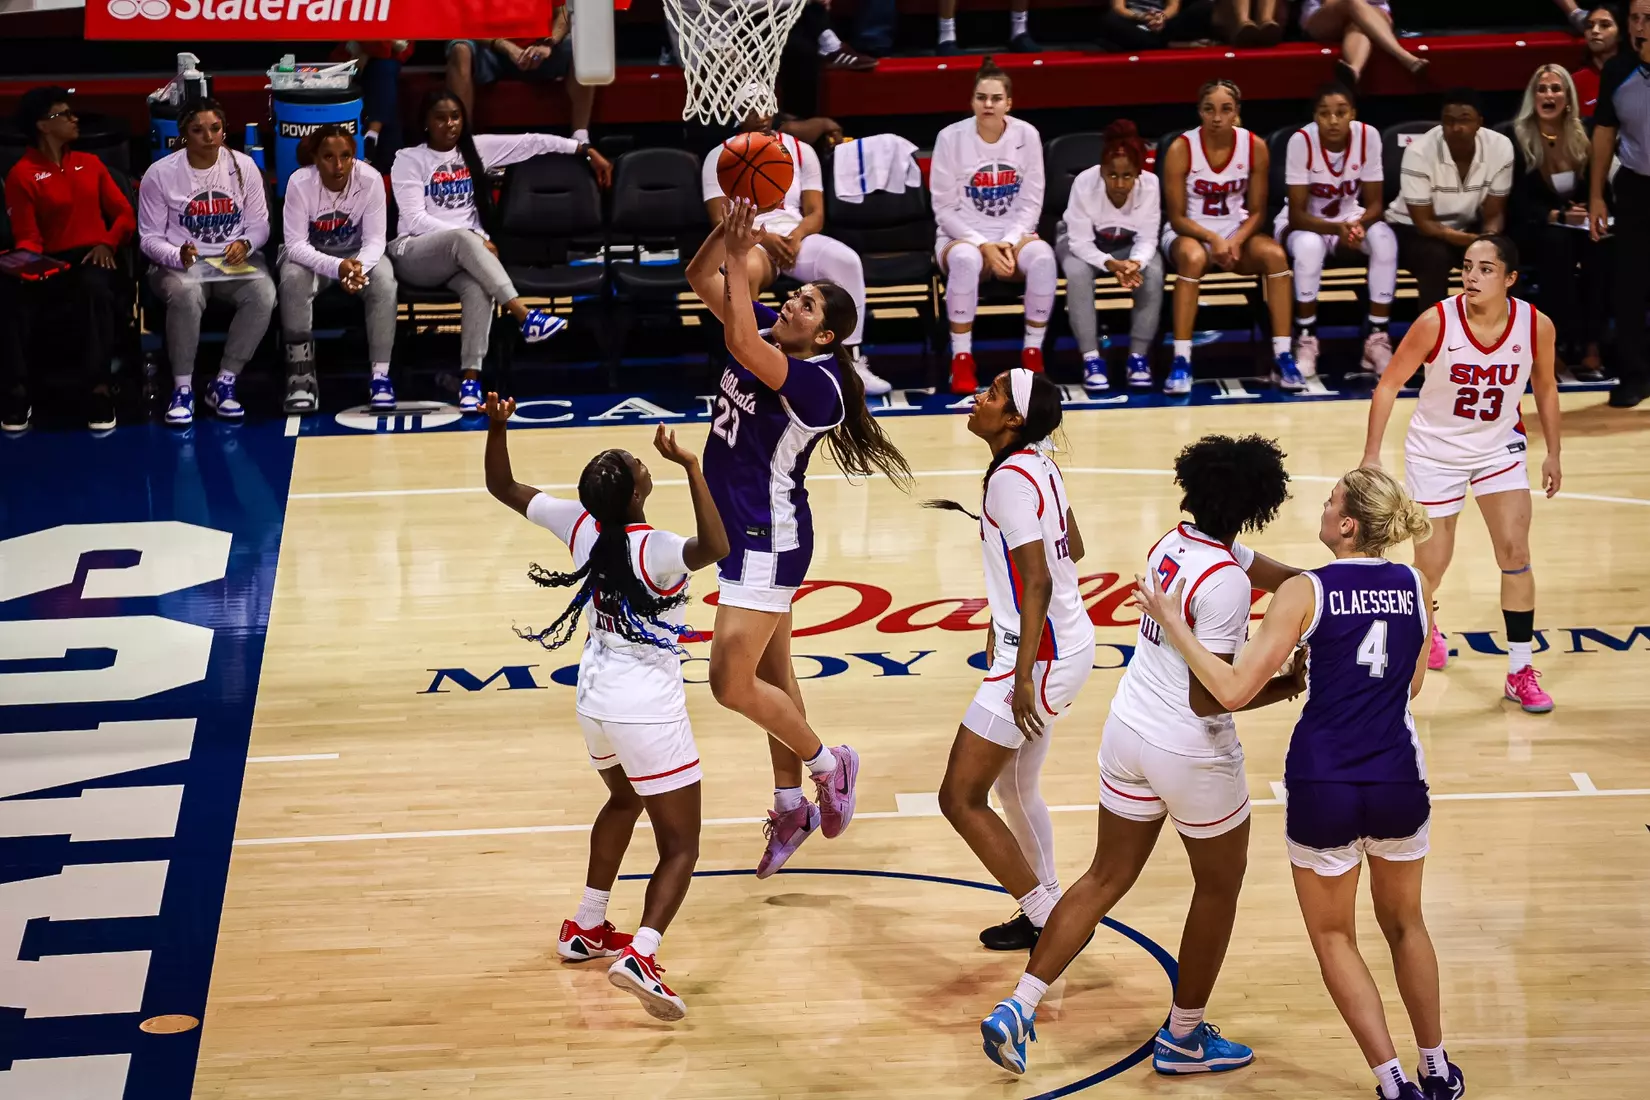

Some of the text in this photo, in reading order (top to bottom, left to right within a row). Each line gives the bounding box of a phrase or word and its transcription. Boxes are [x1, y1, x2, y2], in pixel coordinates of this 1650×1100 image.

[282, 121, 356, 137] POWEE
[1194, 177, 1249, 197] SMU
[1309, 178, 1361, 198] SMU
[188, 197, 237, 216] SALUTE
[1449, 363, 1520, 386] SMU
[1453, 387, 1505, 422] 23
[712, 396, 740, 448] 23
[1157, 553, 1182, 594] 7
[1328, 589, 1415, 616] CLAESSENS
[1356, 619, 1389, 678] 4
